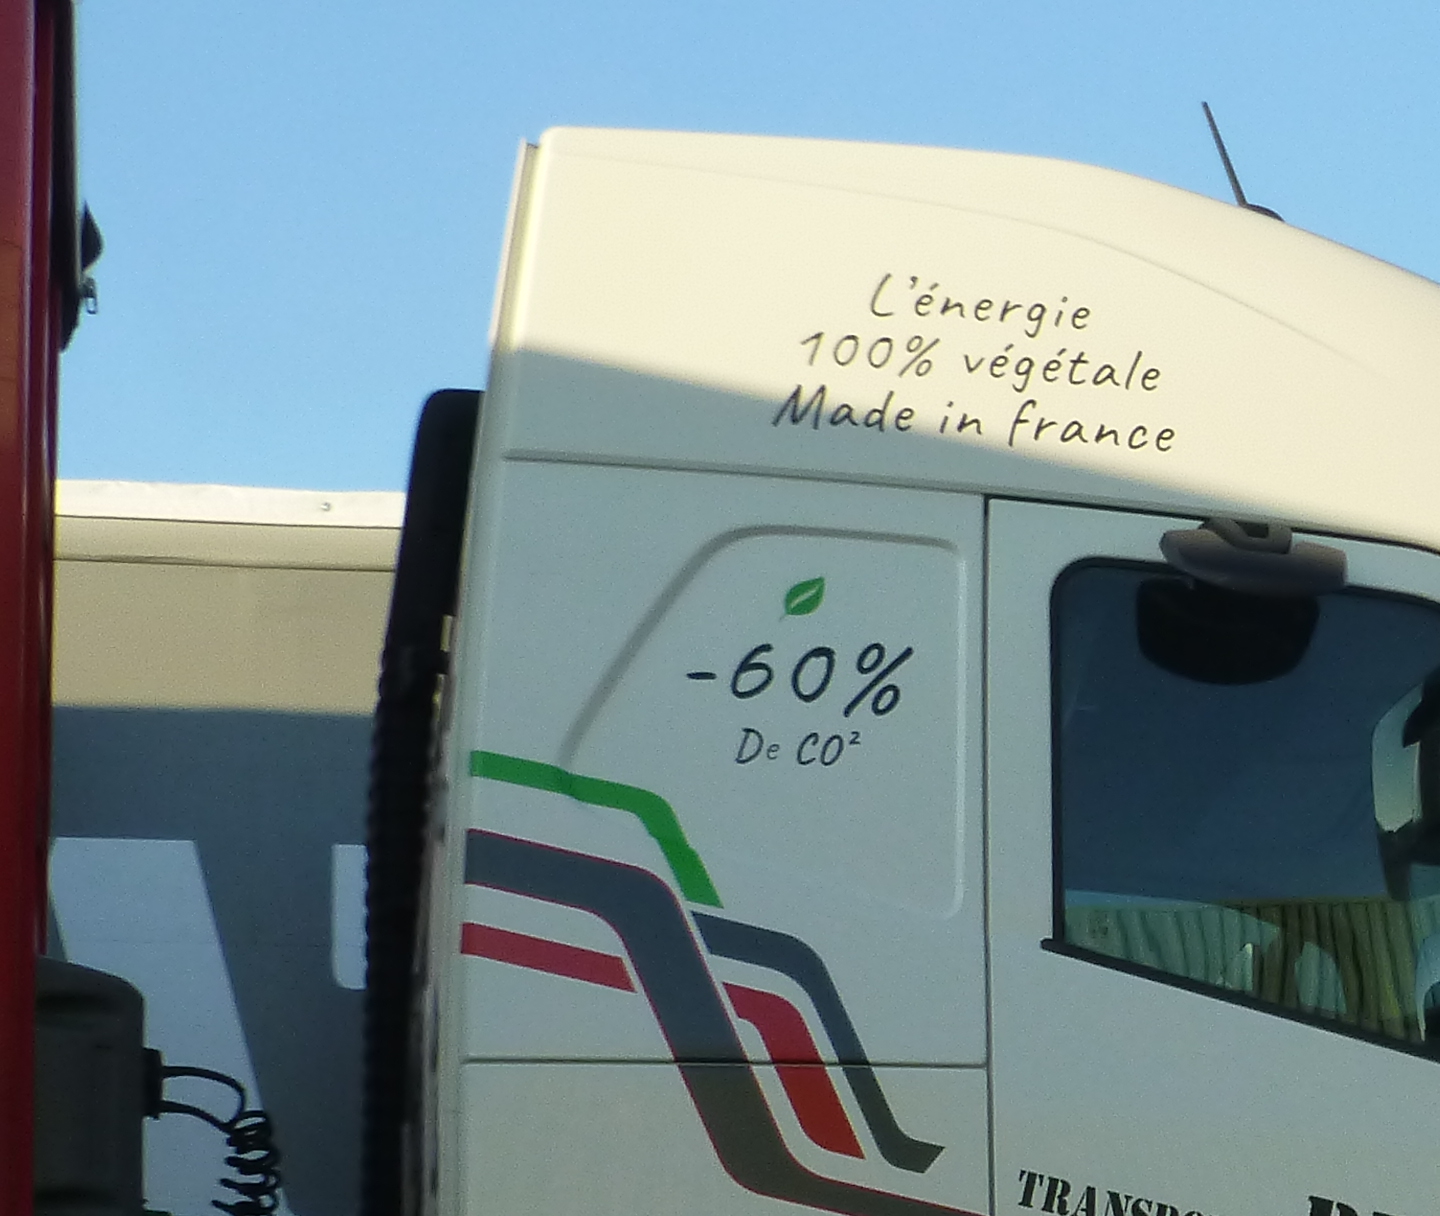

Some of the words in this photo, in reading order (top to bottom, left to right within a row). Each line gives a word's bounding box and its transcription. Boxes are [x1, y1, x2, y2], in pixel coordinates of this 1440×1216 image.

[869, 272, 1092, 338] L'énergie
[799, 332, 940, 378] 100%
[963, 343, 1163, 393] végétale
[771, 384, 916, 433] Made
[938, 397, 985, 437] in
[1008, 399, 1176, 455] france
[685, 642, 914, 719] -60%
[734, 726, 781, 766] De
